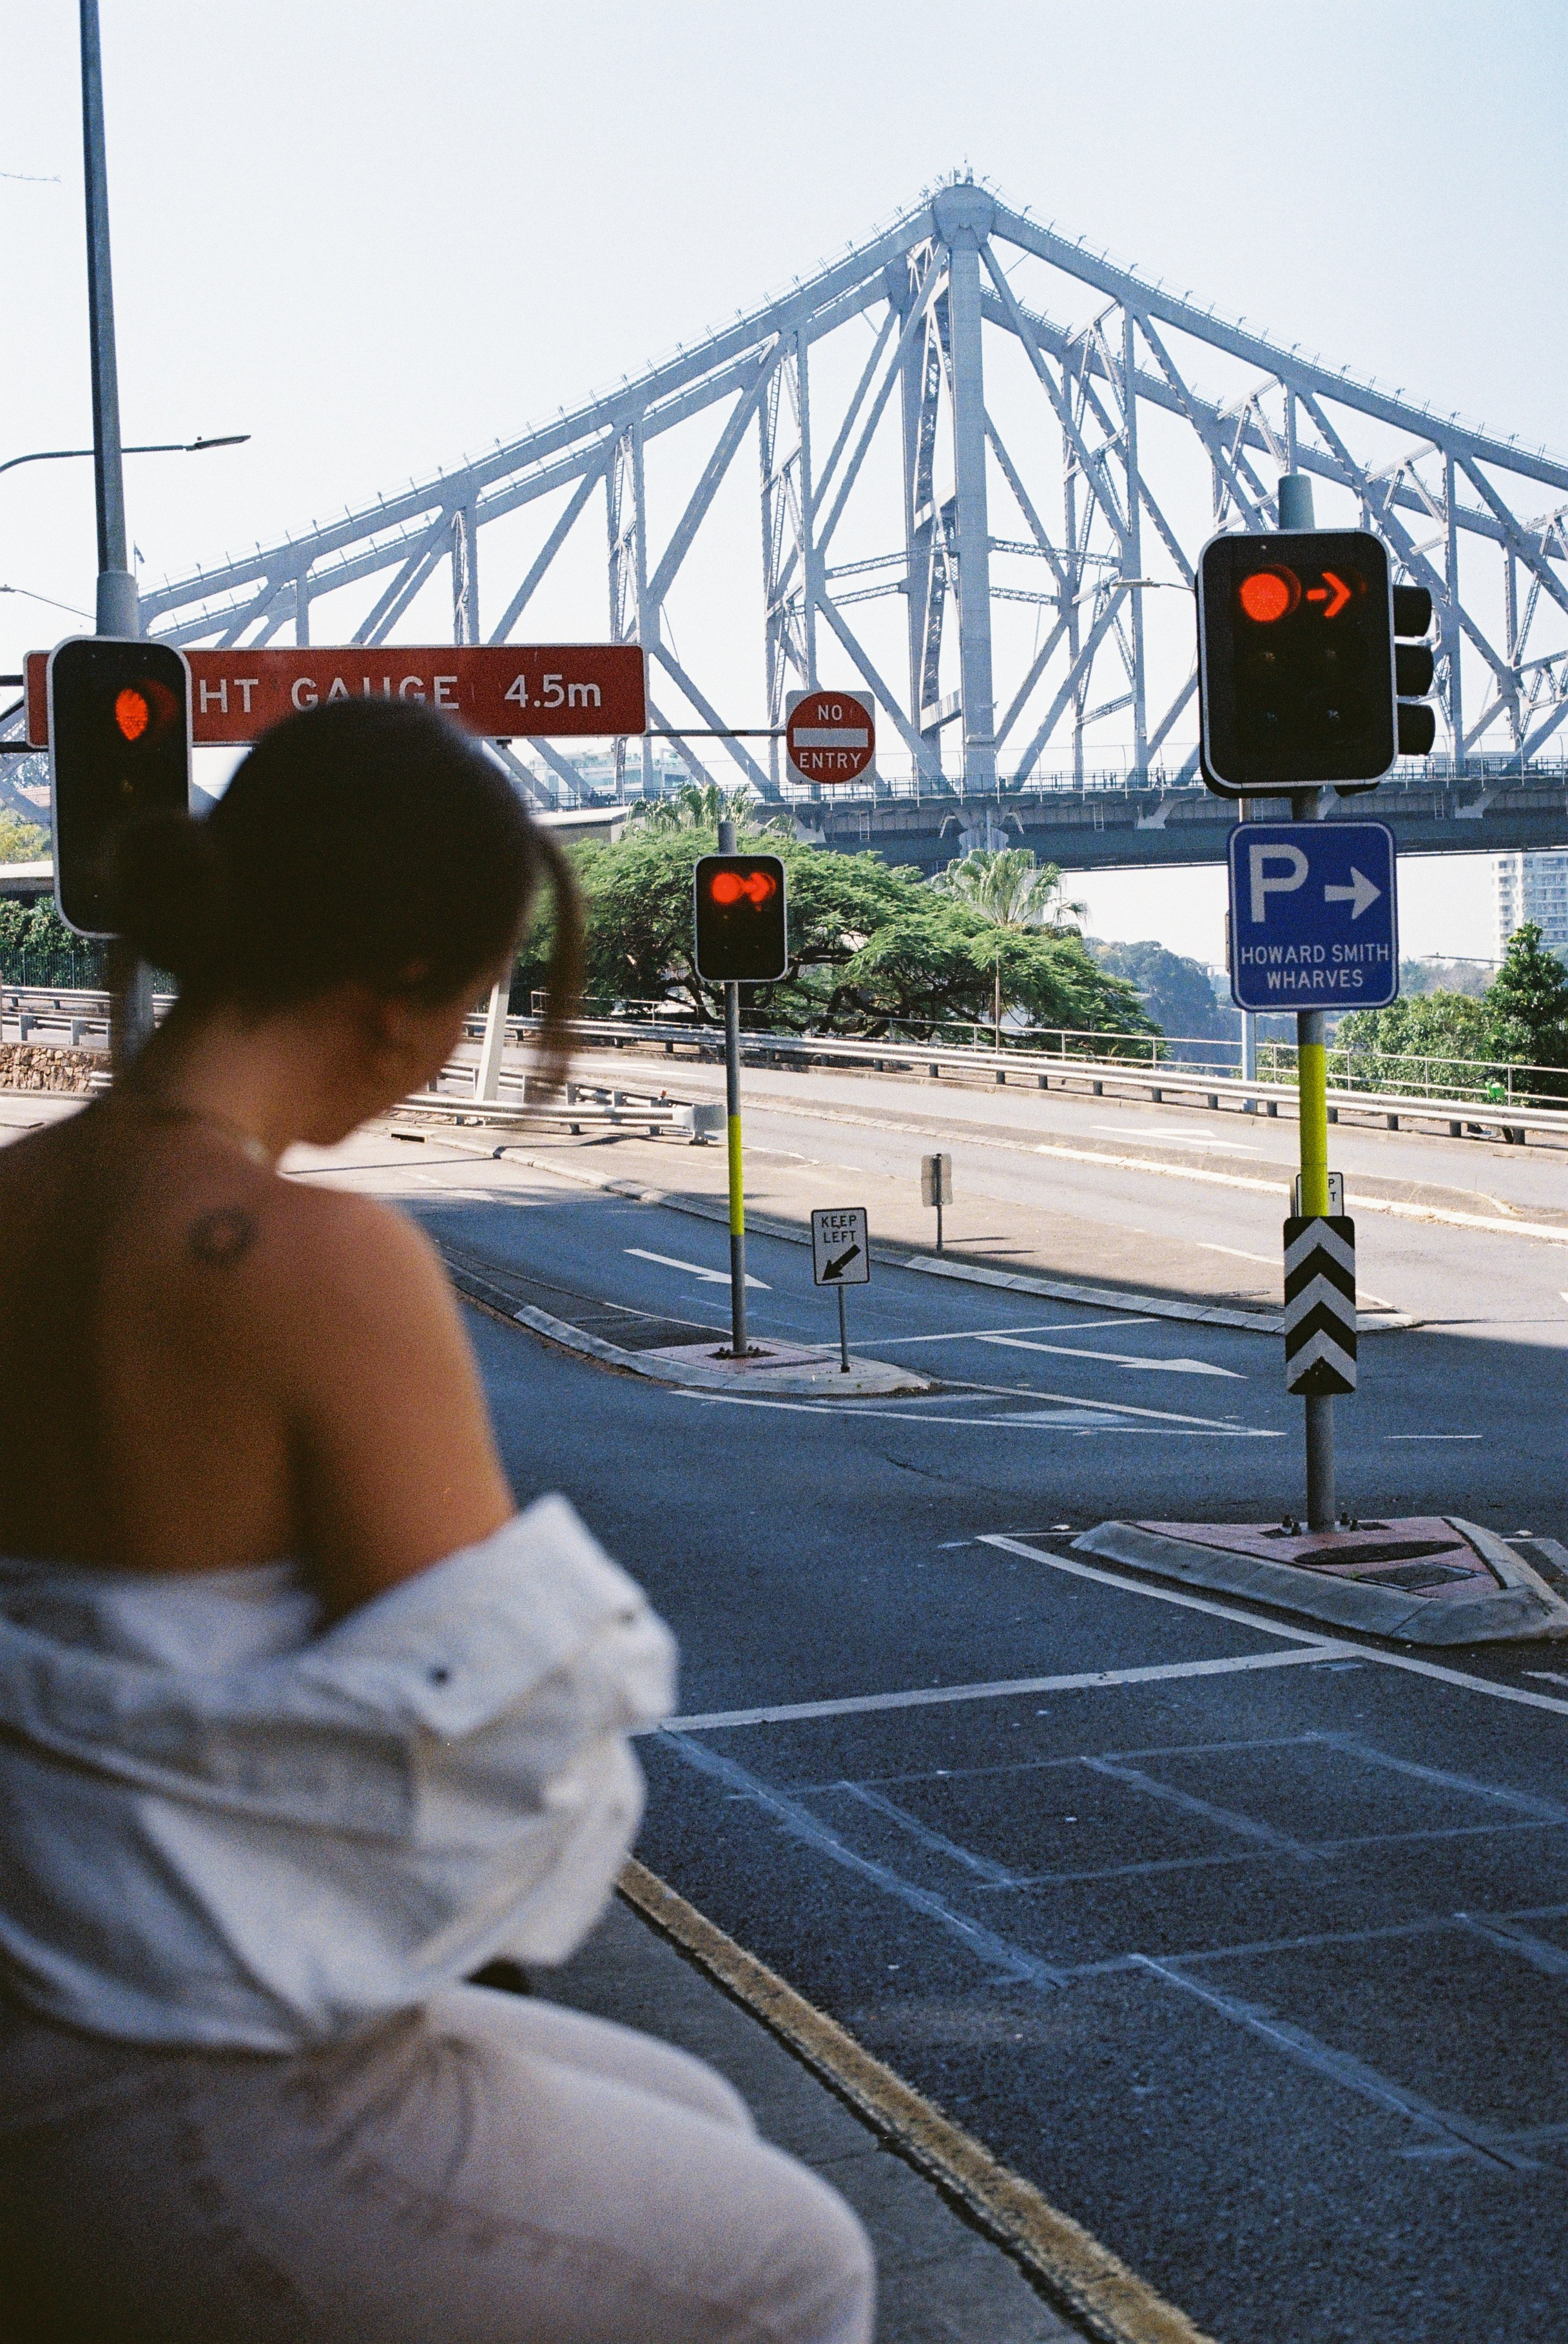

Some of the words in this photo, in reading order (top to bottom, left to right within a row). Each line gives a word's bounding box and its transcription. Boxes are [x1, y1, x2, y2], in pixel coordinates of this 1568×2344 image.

[291, 675, 460, 712] GAUGE
[504, 674, 601, 708] 4.5m
[817, 704, 842, 721] NO
[799, 752, 862, 768] ENTRY
[1248, 844, 1309, 923] P
[1241, 945, 1326, 965] HOWARD
[1331, 943, 1389, 963] SMITH
[1266, 969, 1364, 989] WHARVES
[821, 1215, 857, 1228] KEEP
[824, 1230, 857, 1243] LEFT
